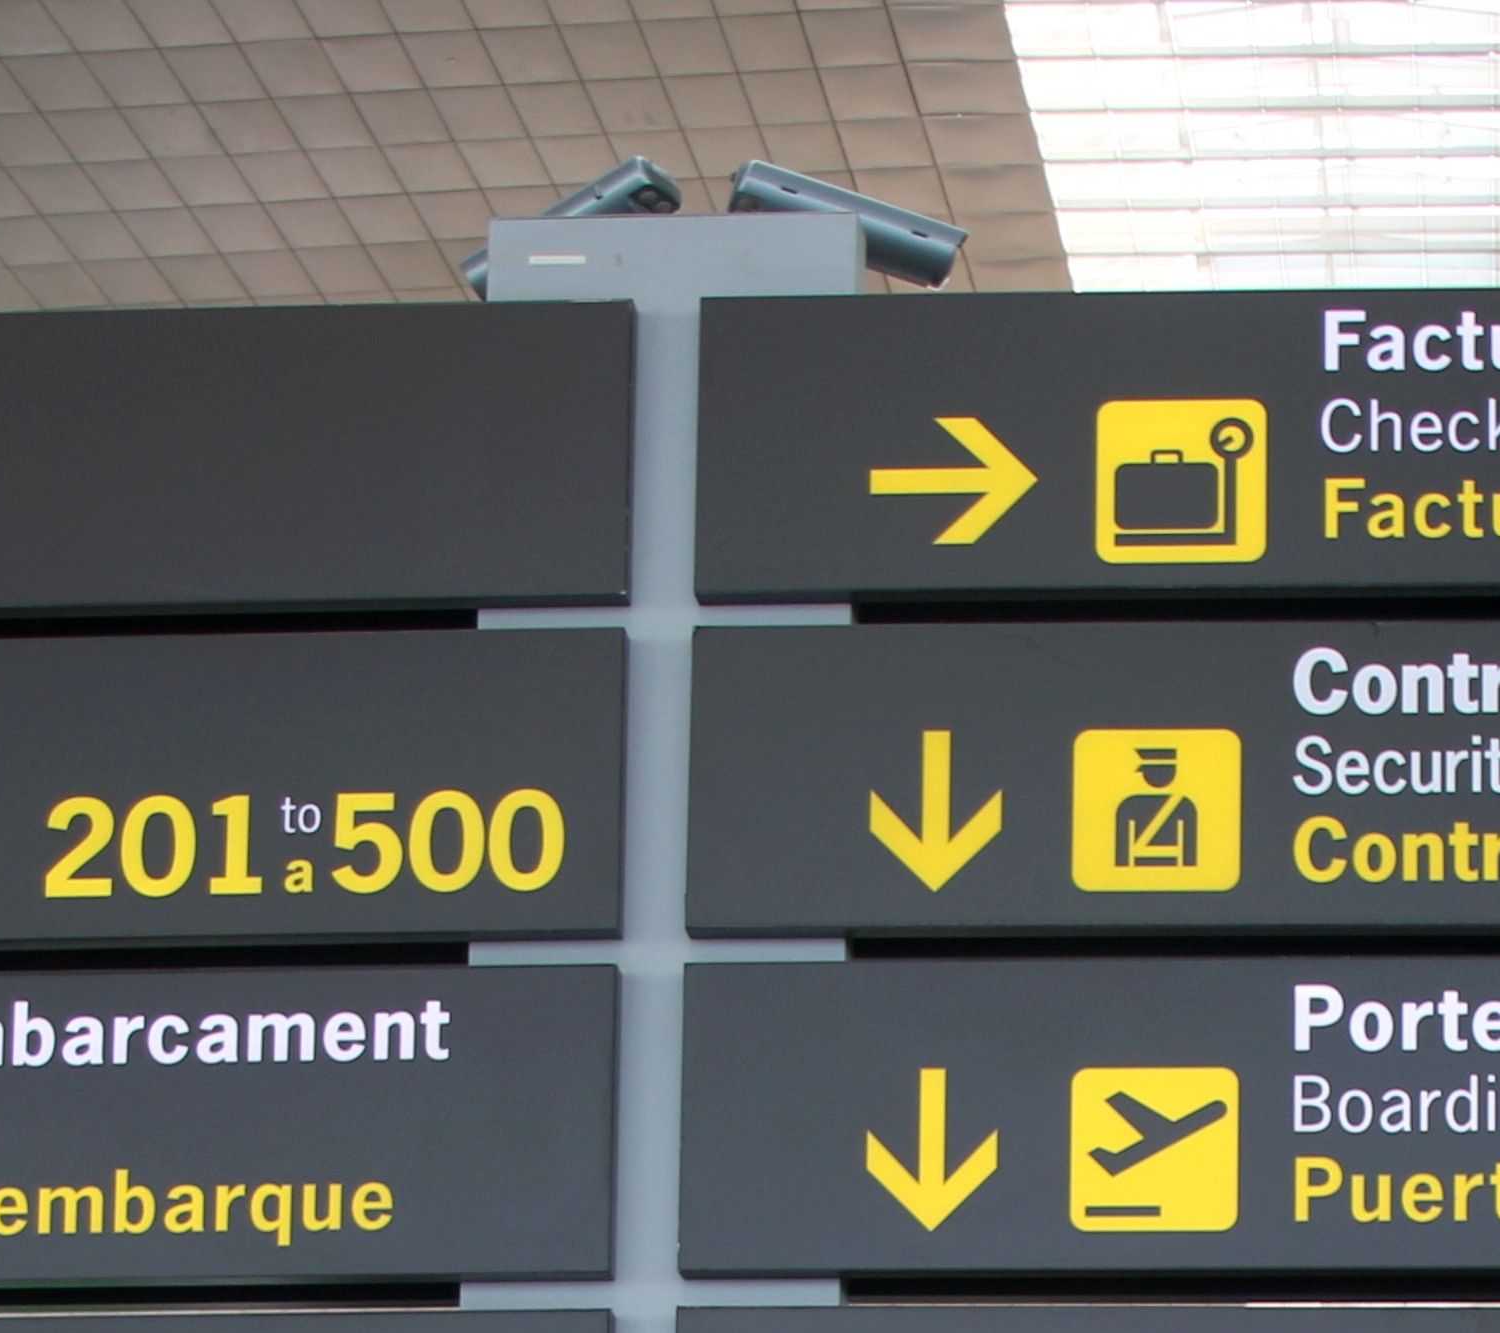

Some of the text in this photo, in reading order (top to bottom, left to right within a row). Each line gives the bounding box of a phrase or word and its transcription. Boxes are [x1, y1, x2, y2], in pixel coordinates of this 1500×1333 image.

[45, 795, 262, 897] 201
[281, 797, 321, 833] to
[332, 789, 564, 893] 500
[284, 860, 312, 892] a
